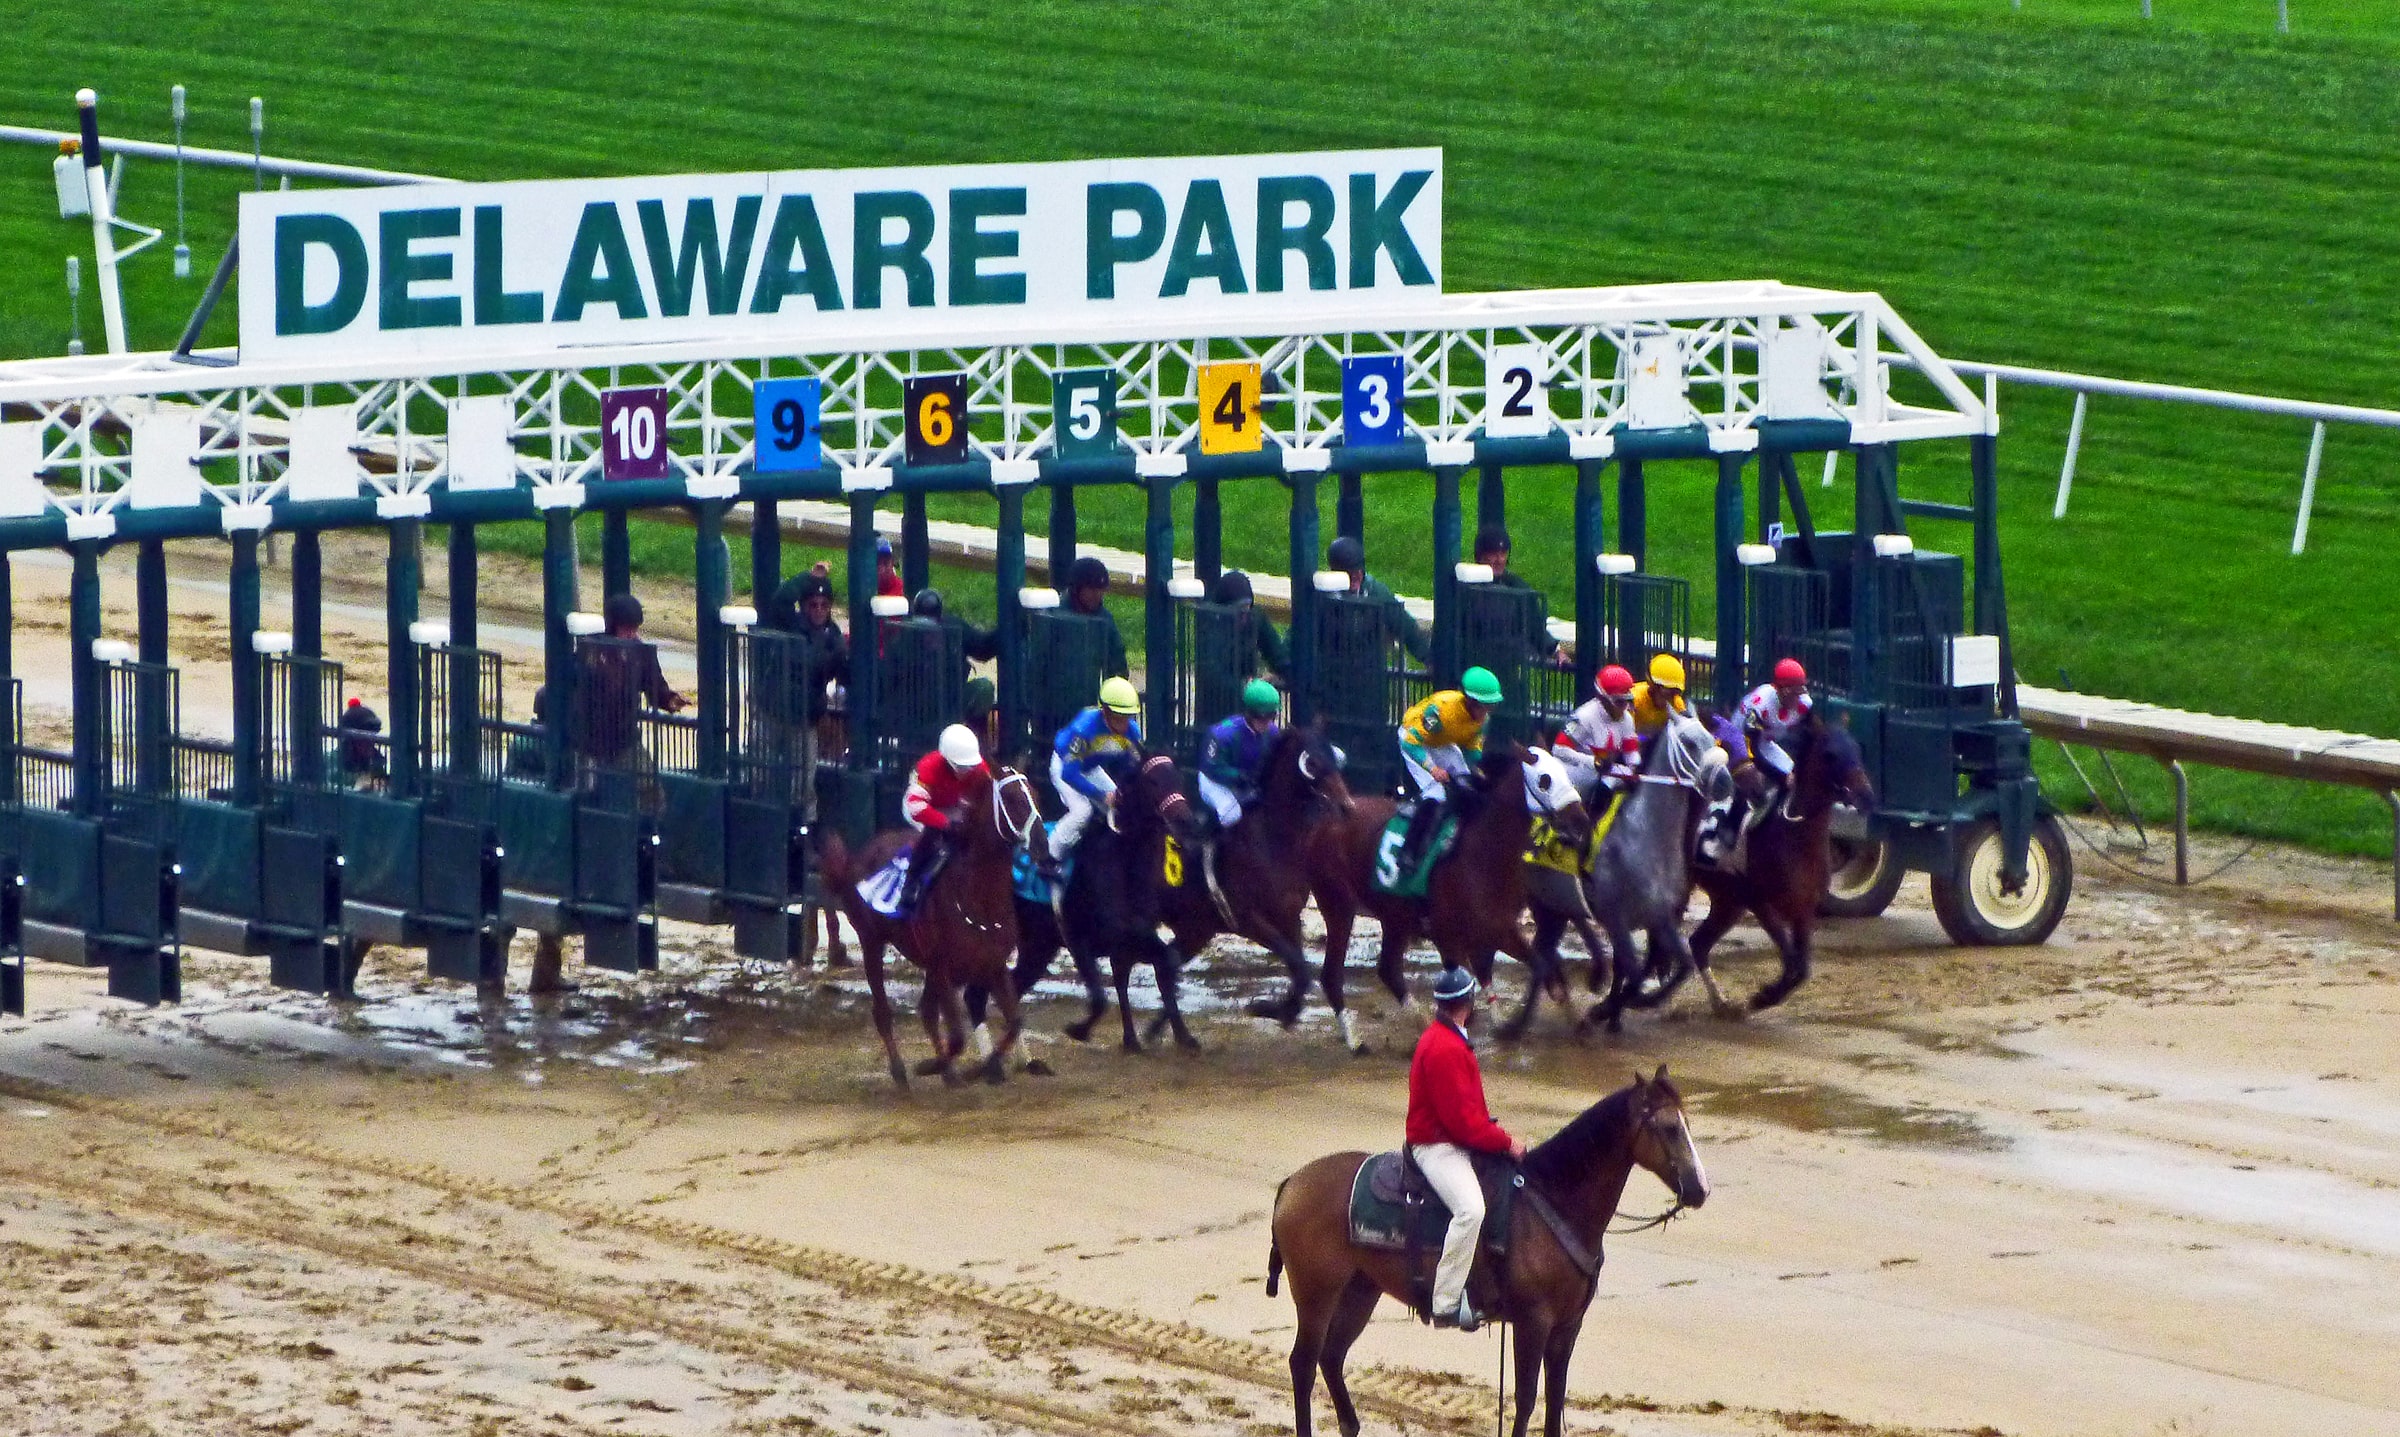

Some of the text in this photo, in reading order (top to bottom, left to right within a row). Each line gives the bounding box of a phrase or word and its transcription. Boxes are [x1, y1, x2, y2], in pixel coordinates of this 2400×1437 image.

[275, 170, 1434, 336] DELAWARE PARK
[919, 392, 953, 447] 6
[1070, 386, 1101, 440] 5
[1214, 382, 1246, 432] 4
[1359, 374, 1391, 429] 3
[1502, 367, 1533, 418] 2
[612, 406, 655, 461] 10
[773, 400, 804, 451] 9
[1164, 835, 1184, 887] 6
[1377, 829, 1405, 888] 5
